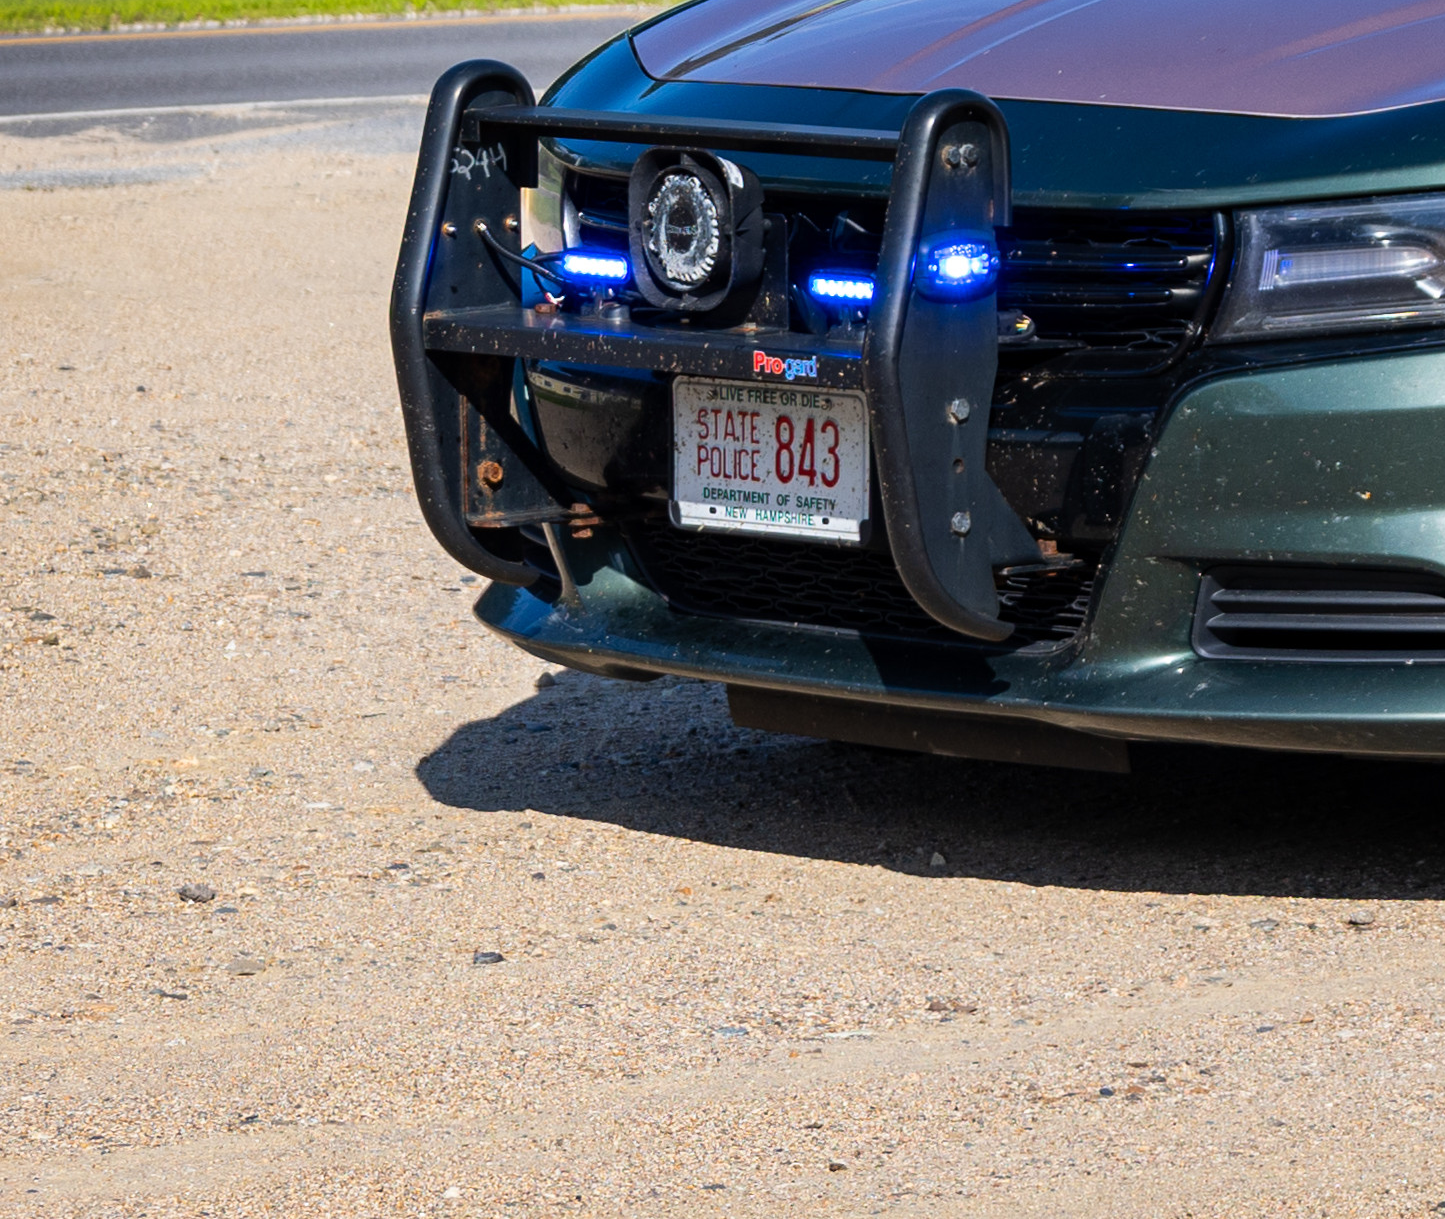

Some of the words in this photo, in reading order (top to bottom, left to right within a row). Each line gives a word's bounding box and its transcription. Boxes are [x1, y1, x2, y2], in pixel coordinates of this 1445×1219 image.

[718, 387, 744, 403] LIVE
[747, 390, 777, 405] FREE
[780, 392, 798, 407] OR
[801, 394, 821, 409] DIE
[697, 408, 761, 444] STATE
[697, 446, 762, 482] POLICE
[775, 415, 841, 488] 843
[703, 487, 771, 506] DEPARTMENT
[776, 493, 791, 506] OF
[796, 496, 837, 511] SAFETY
[725, 506, 747, 520] NEW
[755, 508, 816, 526] HAMPSHIRE
